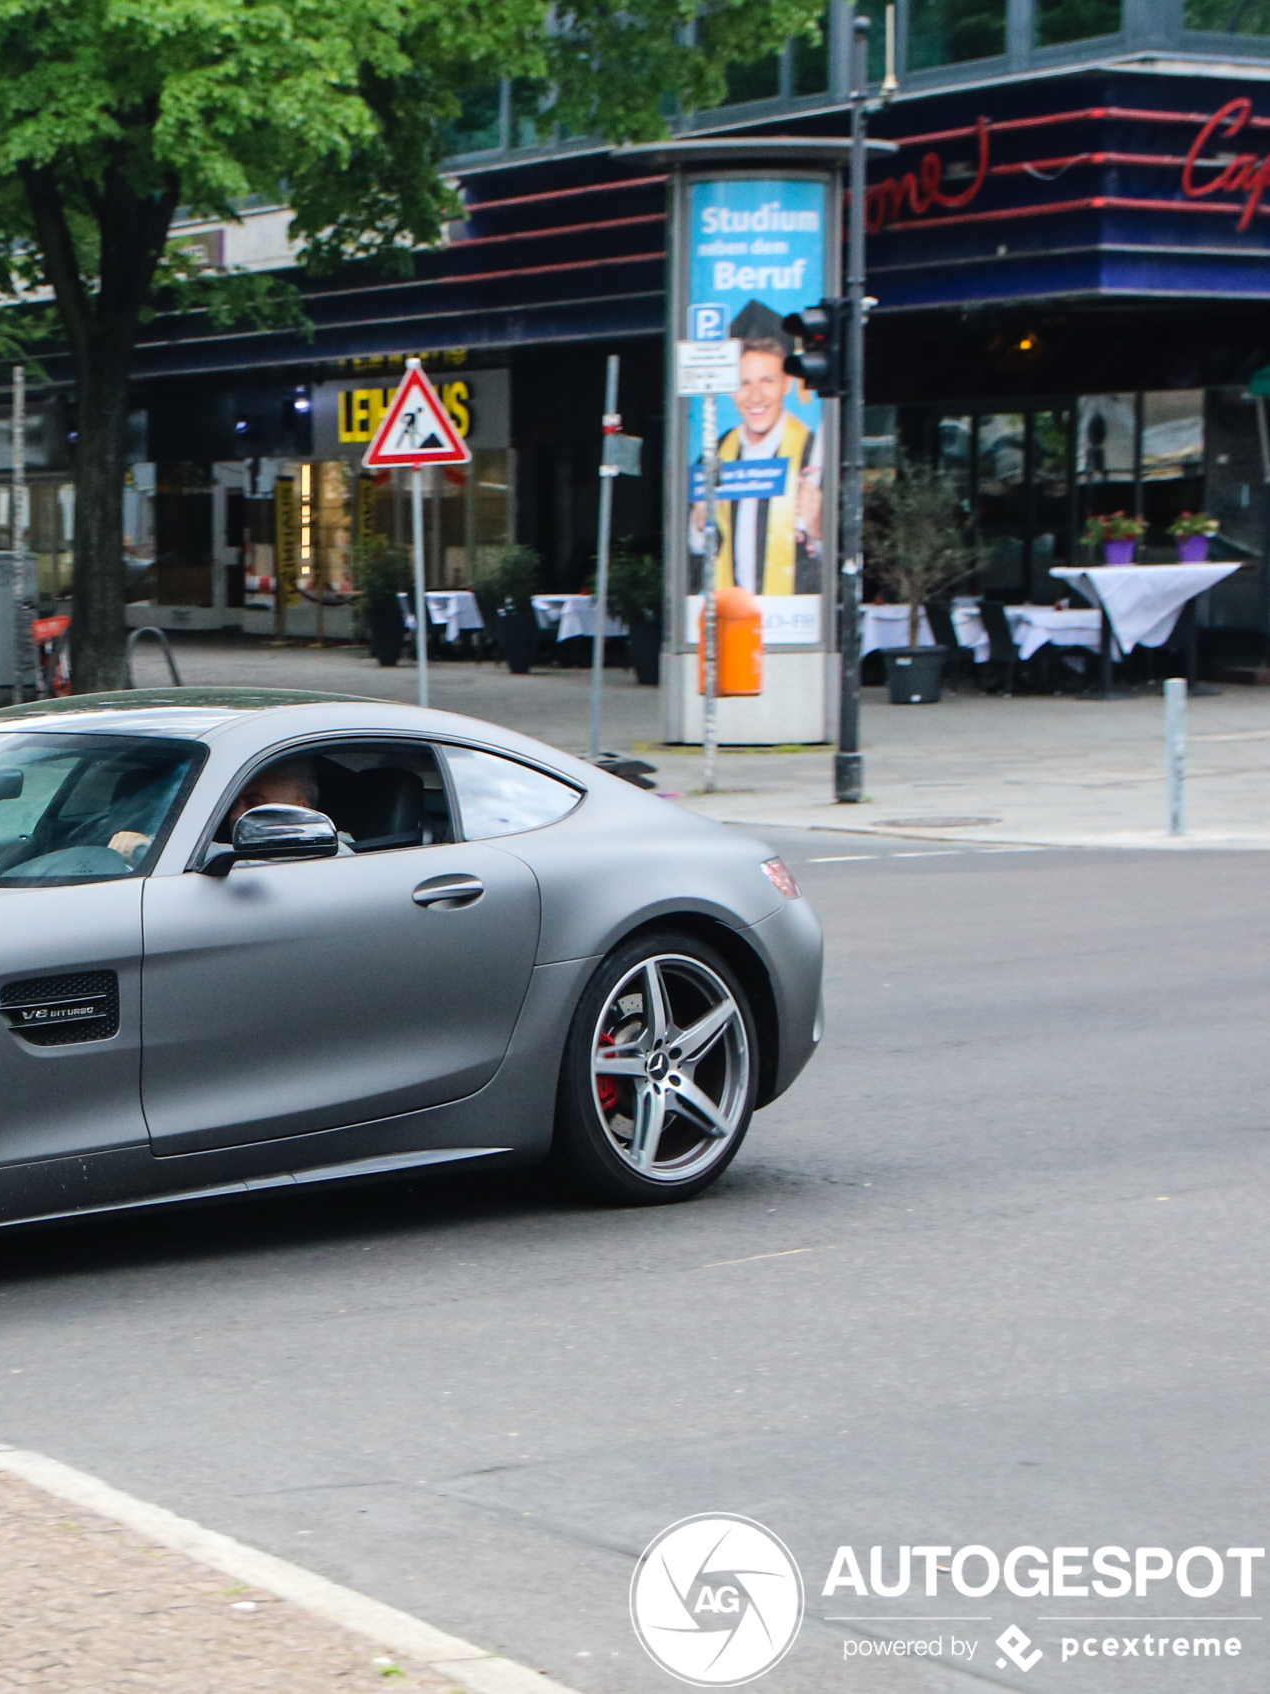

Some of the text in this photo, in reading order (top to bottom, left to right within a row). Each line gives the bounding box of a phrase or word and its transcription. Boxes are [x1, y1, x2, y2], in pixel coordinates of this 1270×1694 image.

[842, 114, 990, 241] one
[701, 201, 820, 233] Studium
[713, 257, 807, 290] Beruf
[338, 381, 470, 443] LEIS
[22, 1006, 94, 1020] V8 BITURBO
